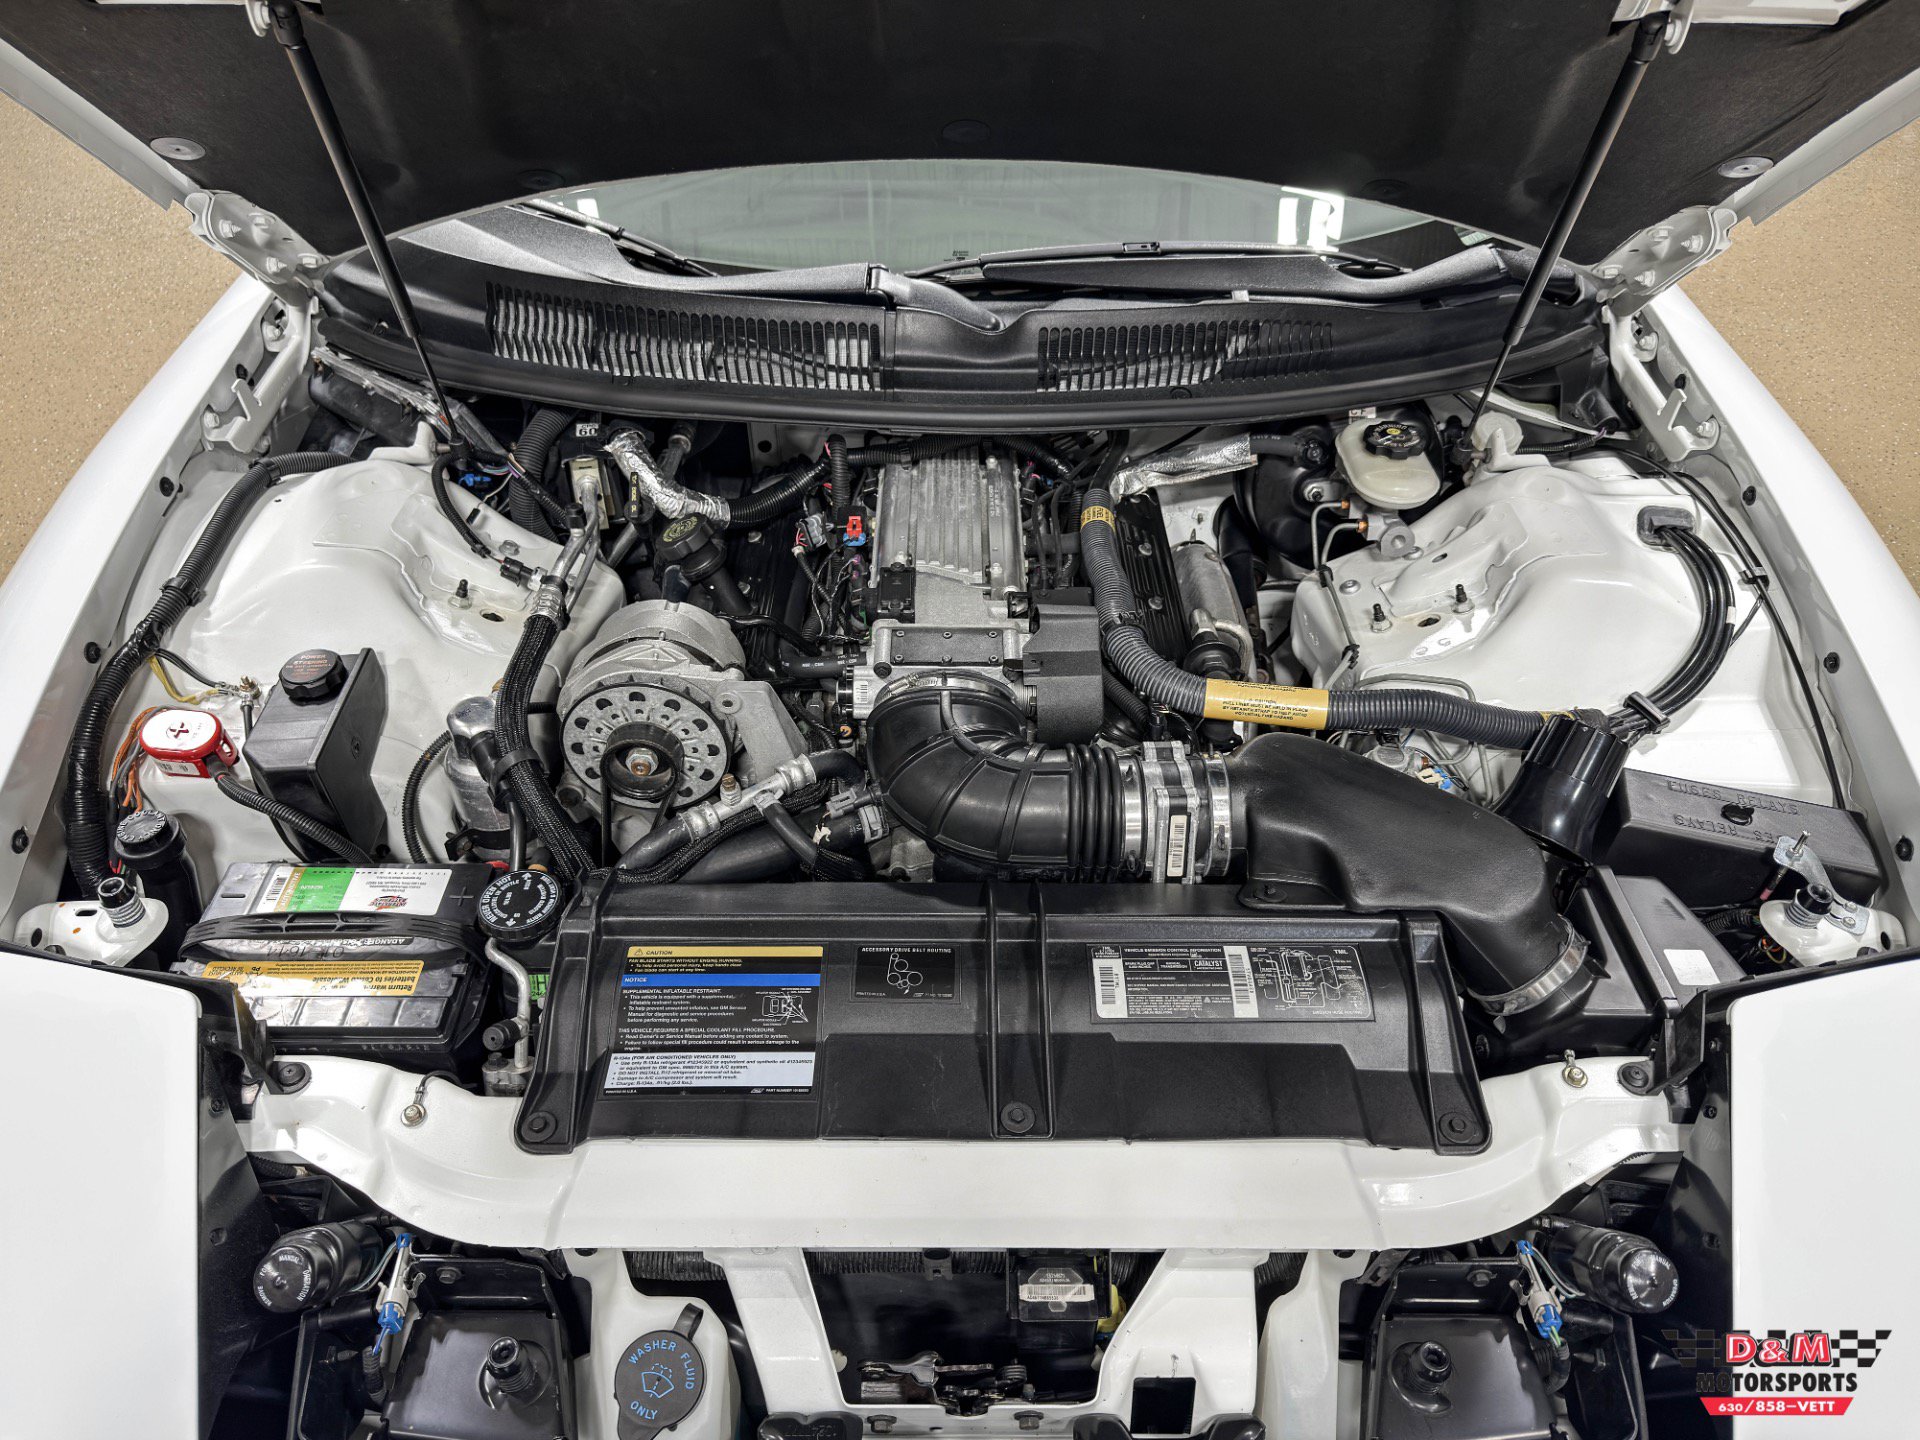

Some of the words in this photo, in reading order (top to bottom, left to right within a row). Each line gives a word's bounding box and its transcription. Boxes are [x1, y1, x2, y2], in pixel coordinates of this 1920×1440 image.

[1667, 780, 1722, 800] FUSES
[1736, 793, 1799, 815] RELAYS
[495, 875, 512, 887] HOT
[482, 886, 497, 903] OPEN
[482, 904, 498, 923] NEVER
[257, 1286, 273, 1306] REMOVE
[296, 1269, 312, 1301] OPERATION
[1662, 1278, 1678, 1307] OPERATION
[628, 1340, 677, 1364] WASHER
[681, 1352, 696, 1390] FLUID
[630, 1400, 658, 1420] ONLY
